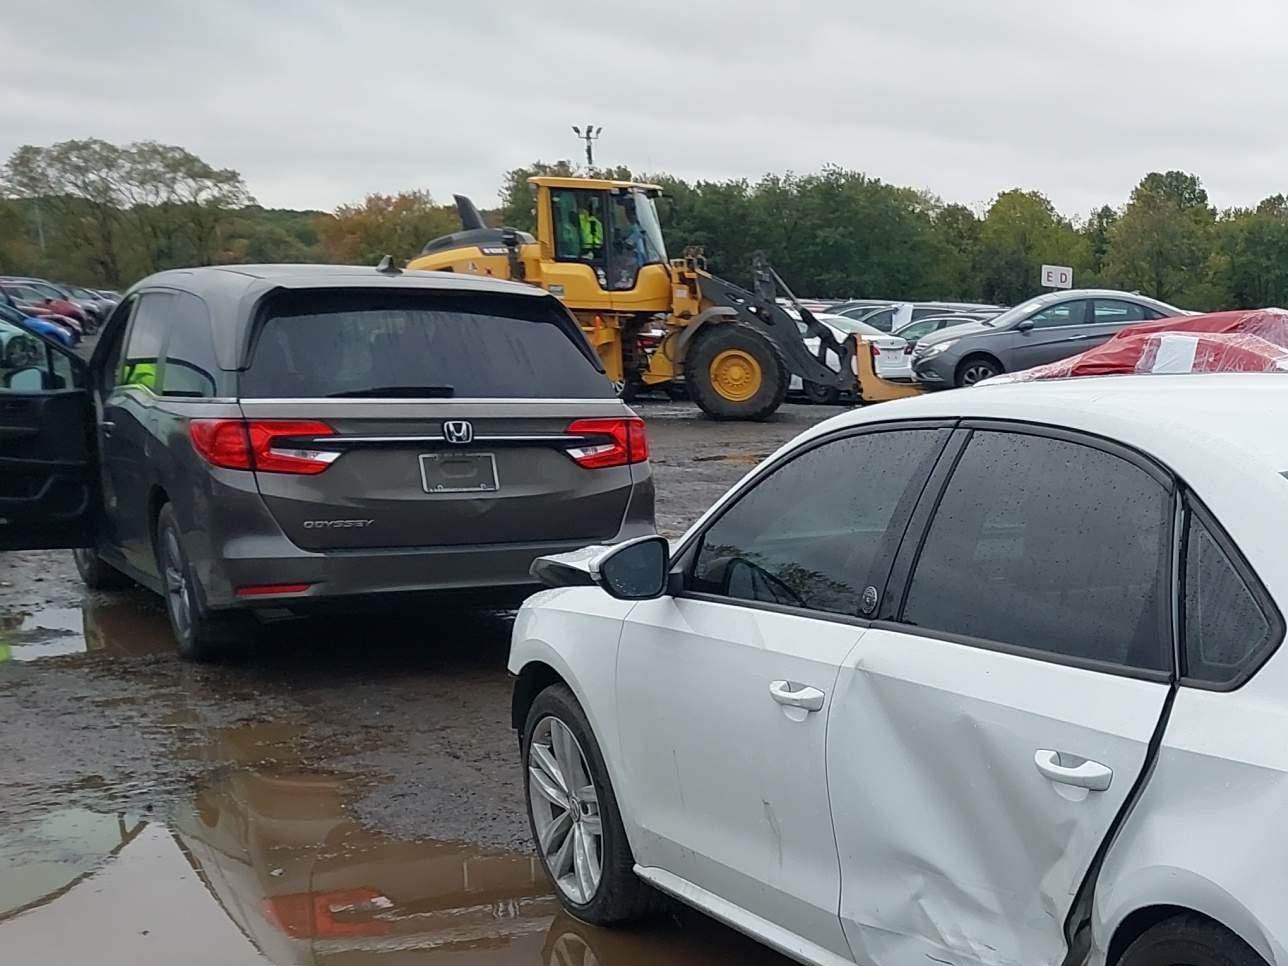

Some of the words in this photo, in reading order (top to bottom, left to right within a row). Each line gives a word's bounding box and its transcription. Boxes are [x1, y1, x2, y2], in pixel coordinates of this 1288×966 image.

[1046, 271, 1054, 283] E
[1059, 272, 1068, 284] D
[303, 519, 375, 529] ODYSSEY
